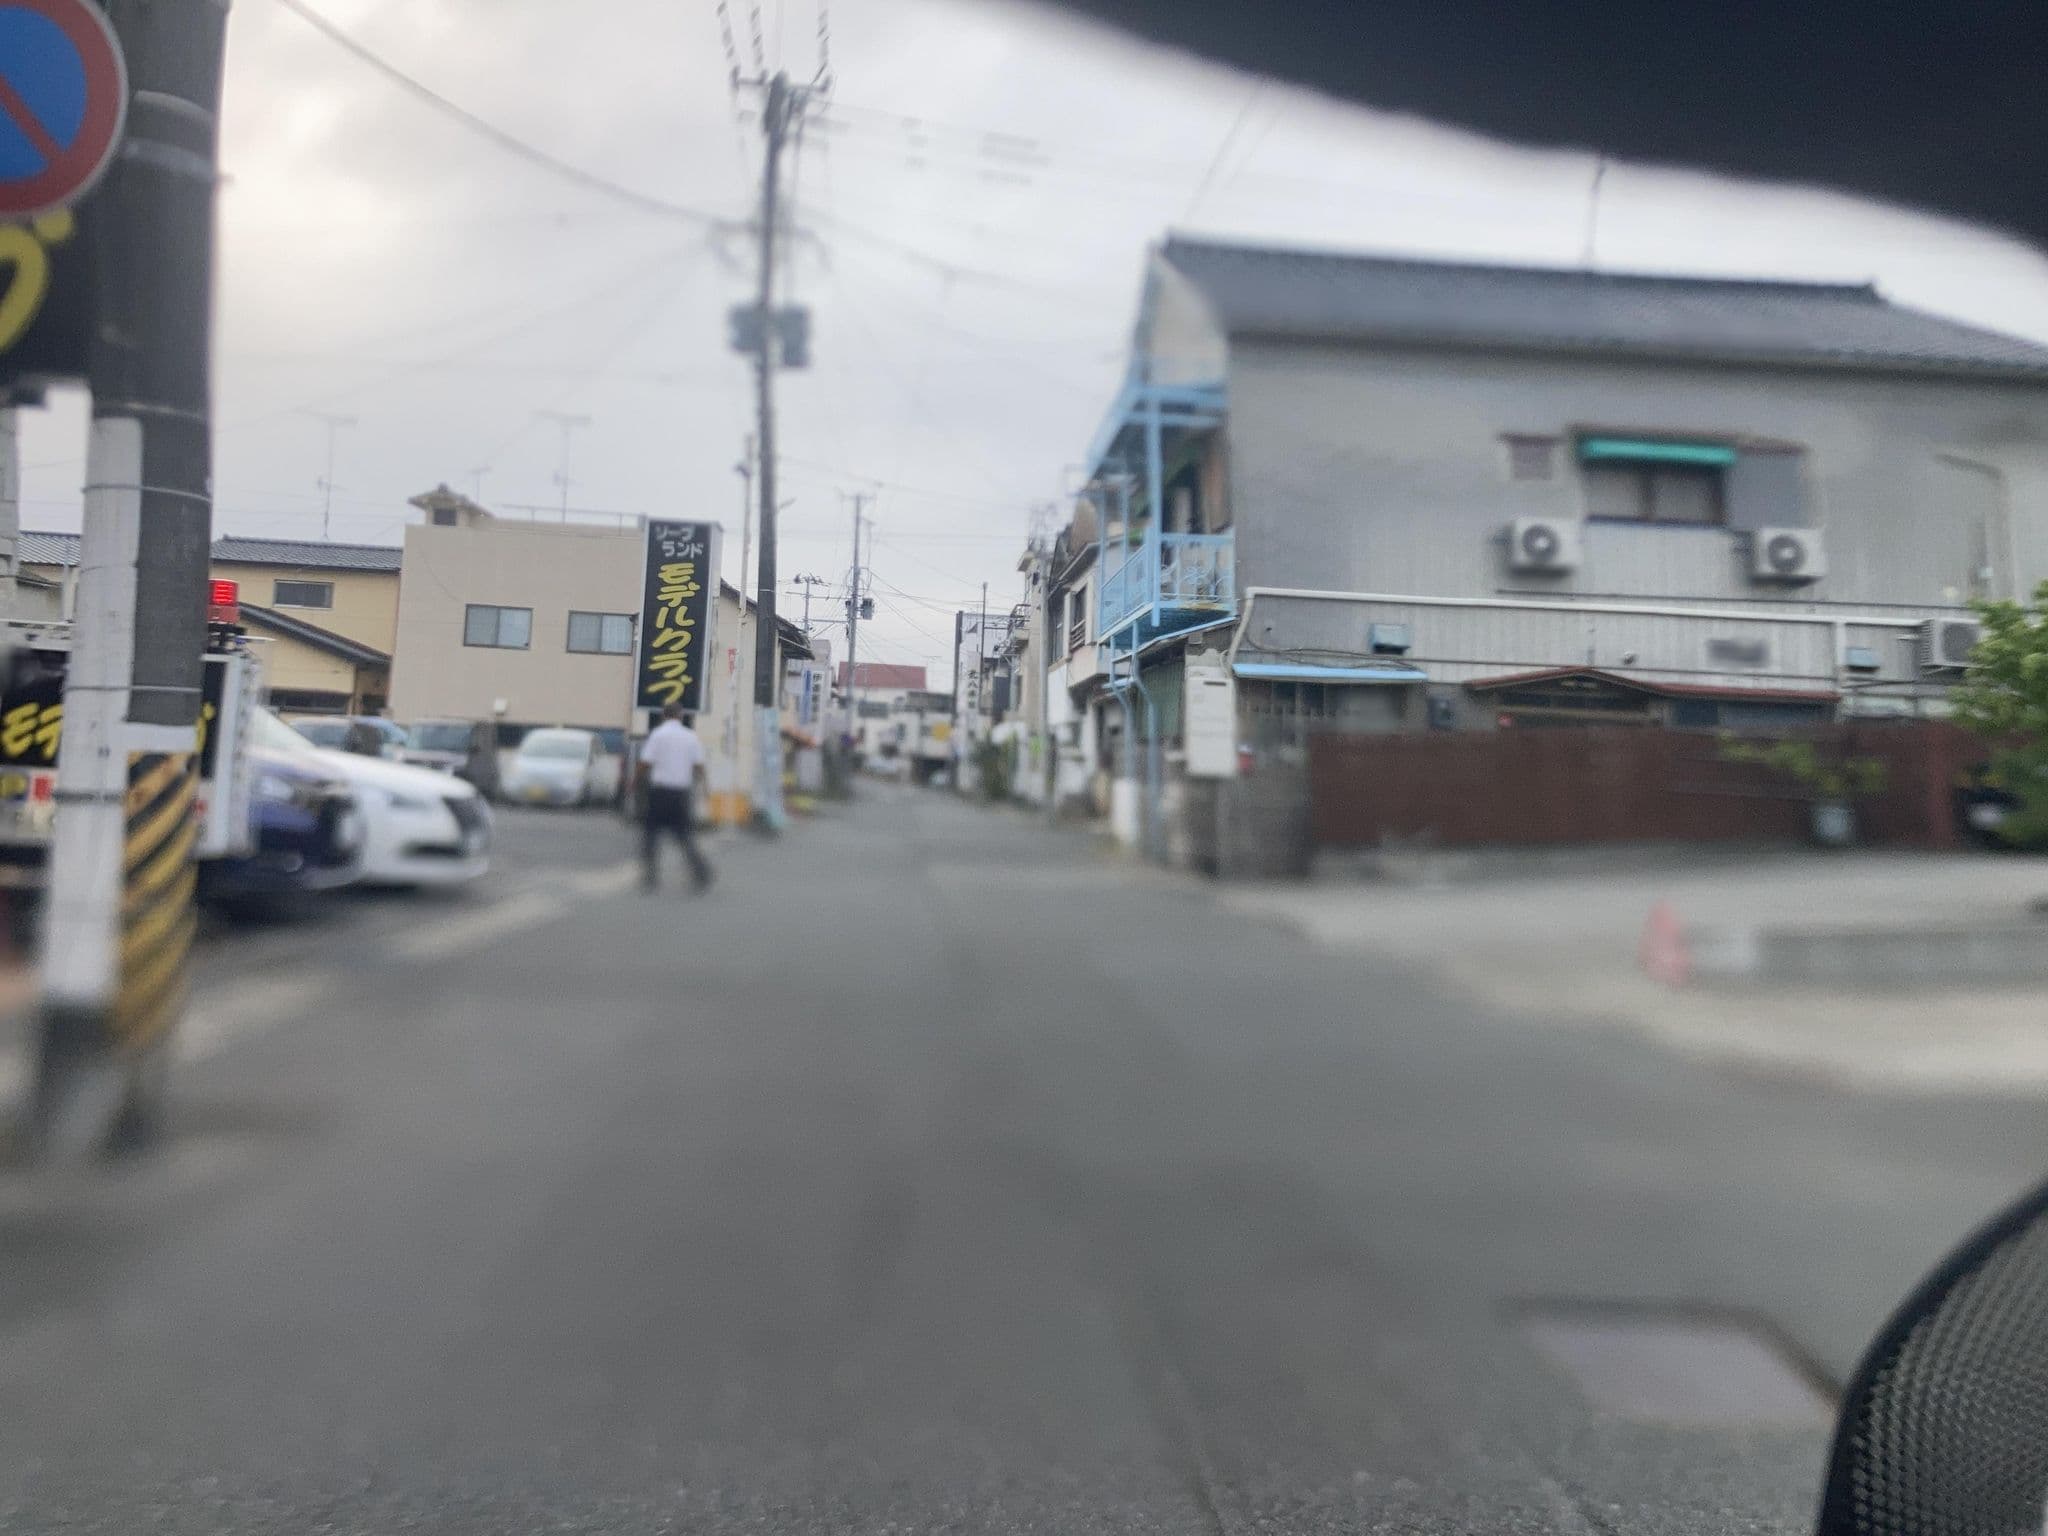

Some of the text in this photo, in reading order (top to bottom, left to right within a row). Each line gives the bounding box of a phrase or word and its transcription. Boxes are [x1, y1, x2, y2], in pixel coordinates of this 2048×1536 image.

[661, 540, 704, 559] ランド
[647, 562, 701, 705] モデルクラブ
